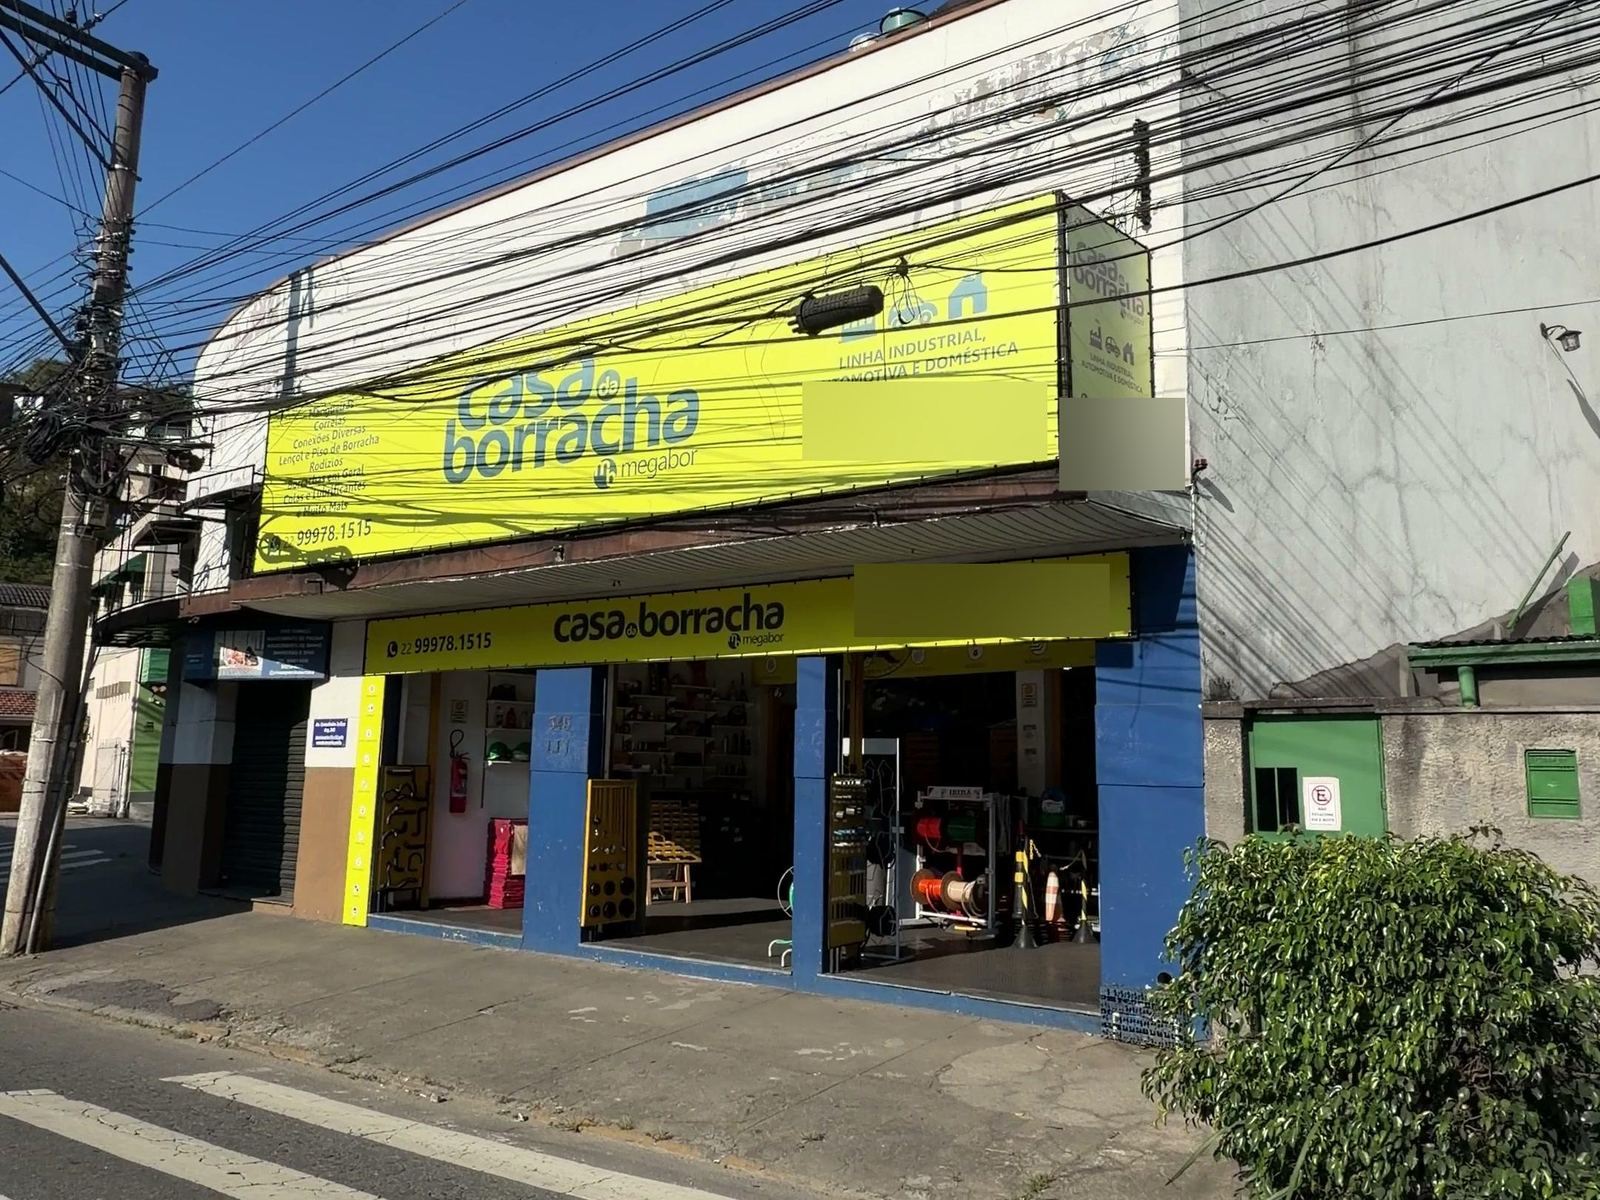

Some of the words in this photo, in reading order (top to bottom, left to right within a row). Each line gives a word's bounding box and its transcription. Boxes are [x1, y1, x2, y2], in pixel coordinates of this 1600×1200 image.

[839, 349, 884, 369] LINHA
[888, 328, 986, 359] INDUSTRIAL,
[912, 361, 920, 376] E
[925, 341, 1019, 372] DOMÉSTICA
[458, 355, 595, 430] casa
[599, 376, 618, 395] da
[293, 434, 330, 450] Conexões
[332, 425, 367, 440] Diversas
[313, 416, 347, 431] Correias
[443, 376, 700, 485] borracha
[279, 450, 304, 467] Lençol
[312, 447, 329, 459] Piso
[330, 443, 341, 455] de
[342, 434, 380, 452] Borracha
[621, 448, 698, 479] megabor
[341, 463, 365, 478] Geral
[297, 521, 372, 546] 99978.1515
[553, 609, 626, 643] casa
[638, 593, 785, 637] borracha
[400, 642, 412, 655] 22
[414, 632, 492, 654] 99978.1515
[742, 632, 784, 648] megabor
